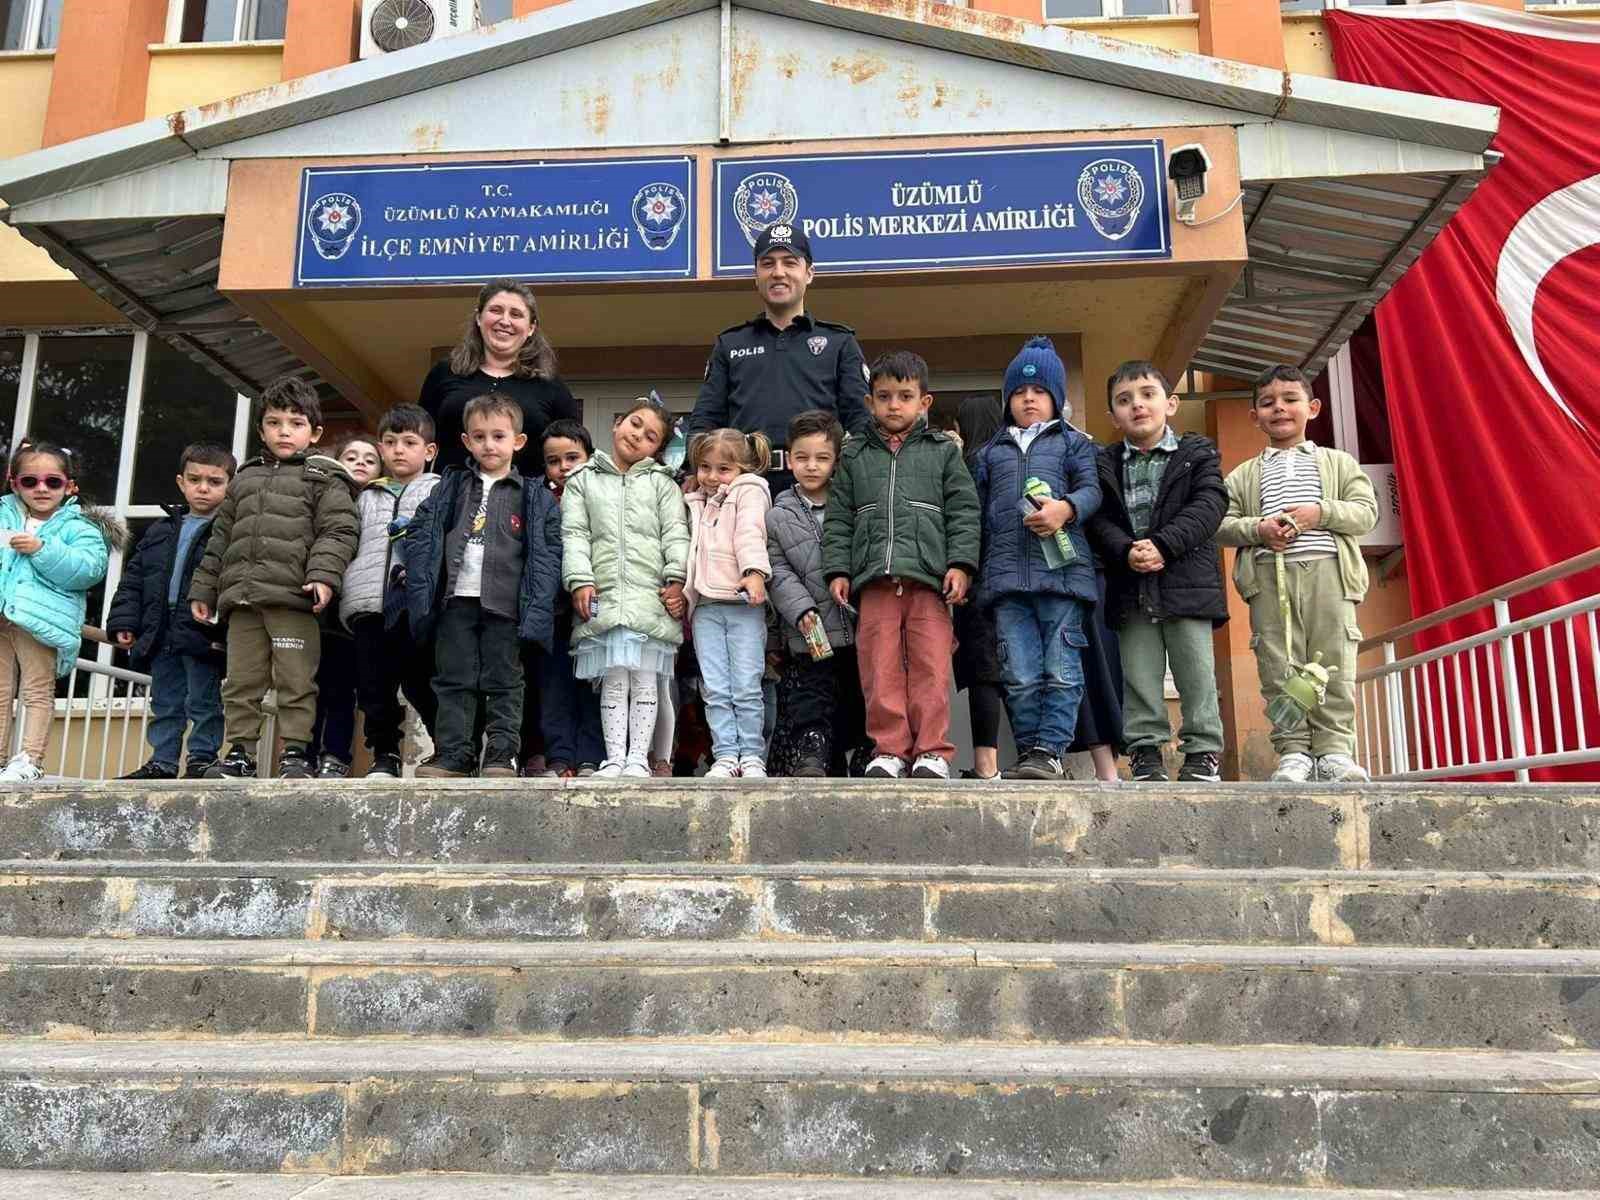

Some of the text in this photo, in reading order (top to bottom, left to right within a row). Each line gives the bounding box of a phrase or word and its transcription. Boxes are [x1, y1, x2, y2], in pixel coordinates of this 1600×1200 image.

[481, 184, 513, 197] T.C.
[891, 180, 983, 207] ÜZÜMLÜ
[384, 200, 609, 222] ÜZÜMLÜ KAYMAKAMLIĞI
[802, 203, 1076, 239] POLİS MERKEZİ AMİRLİĞİ
[361, 227, 629, 261] İLÇE EMNİYET AMİRLİĞİ
